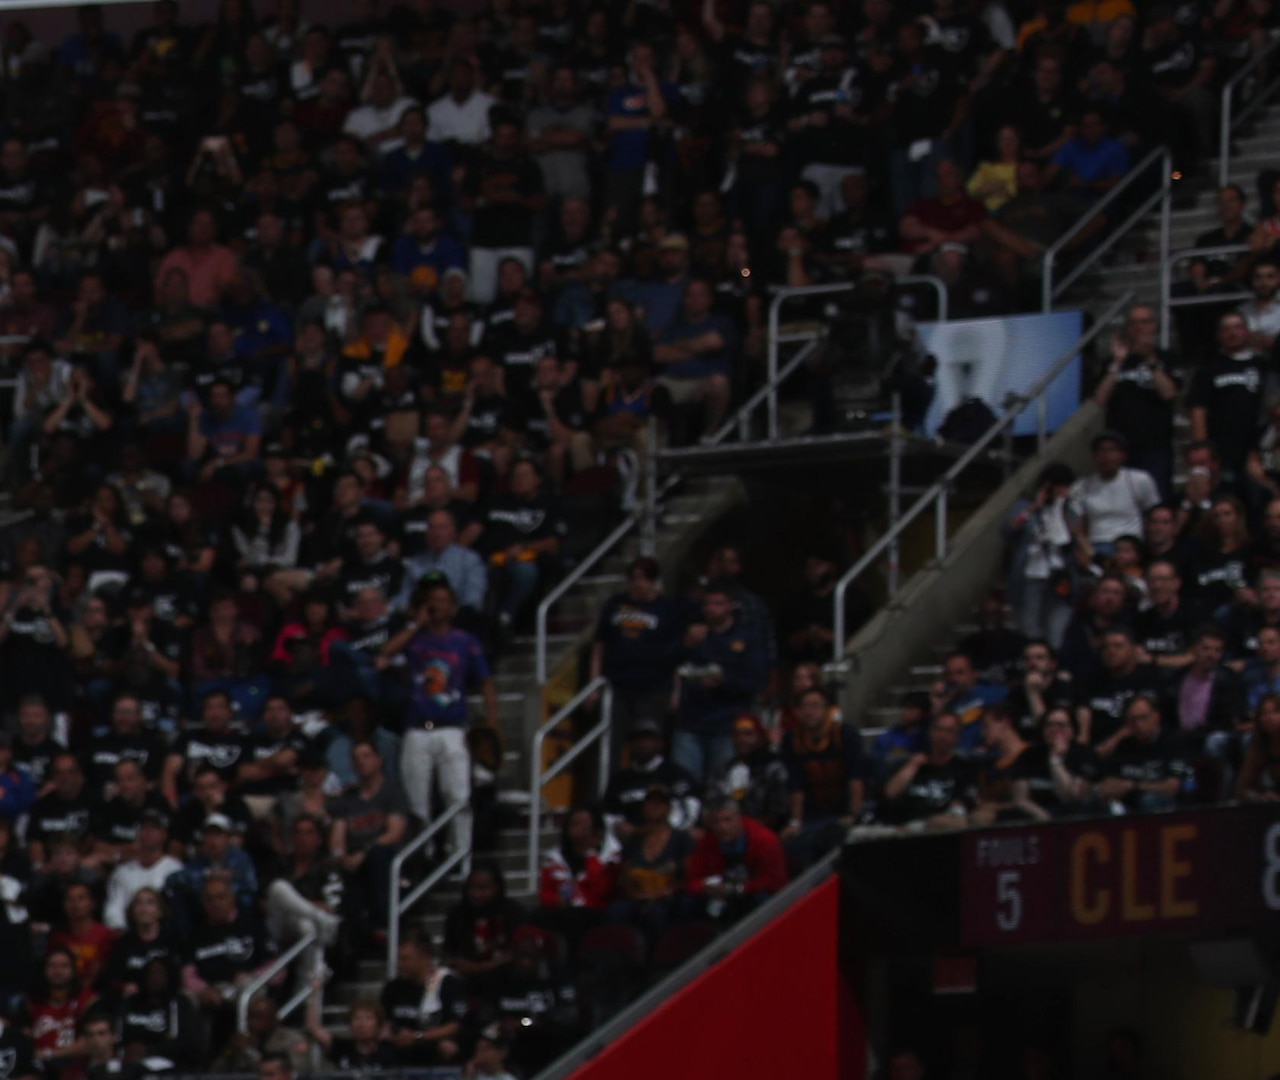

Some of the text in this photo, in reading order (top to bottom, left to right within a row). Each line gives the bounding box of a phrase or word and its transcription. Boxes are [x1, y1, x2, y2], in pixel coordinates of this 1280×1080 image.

[976, 835, 1040, 868] FOULS
[1069, 822, 1200, 926] CLE
[995, 869, 1023, 932] 5
